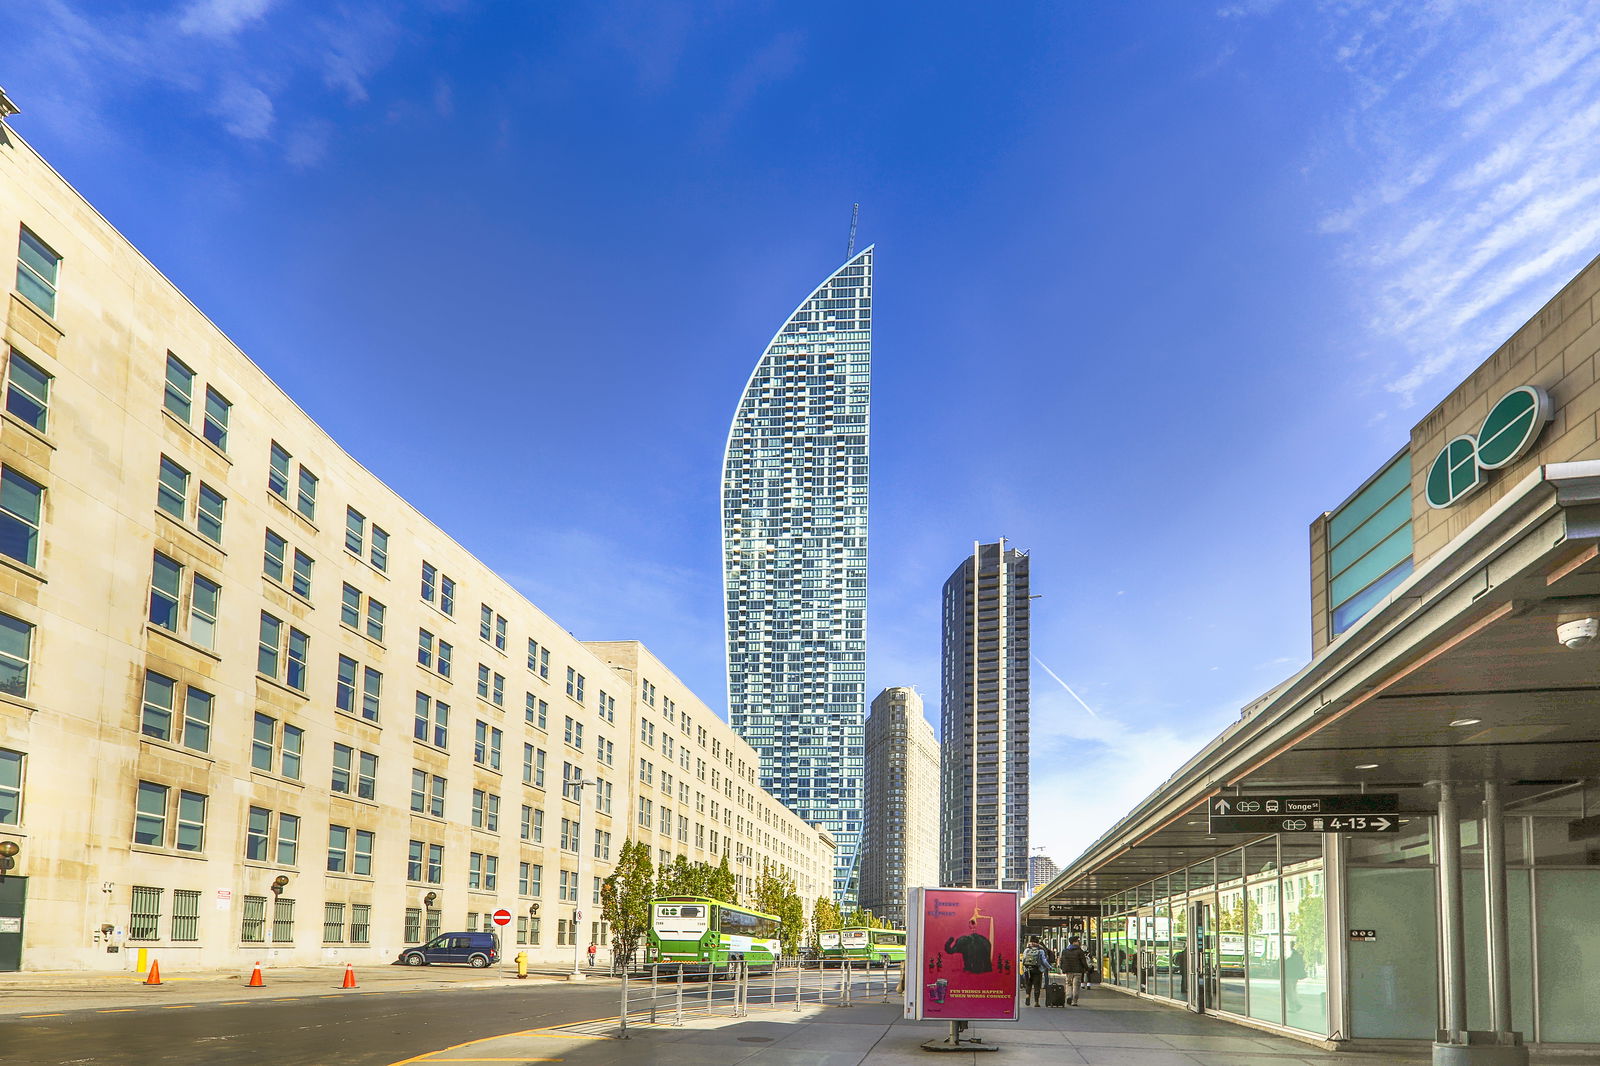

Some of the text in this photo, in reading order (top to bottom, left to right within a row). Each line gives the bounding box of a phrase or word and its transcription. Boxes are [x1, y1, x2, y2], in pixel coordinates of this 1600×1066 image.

[1425, 385, 1540, 510] GO
[1236, 801, 1260, 812] GO
[1287, 803, 1312, 812] Yonge
[1282, 819, 1307, 831] GO
[1330, 817, 1367, 829] 4-13
[661, 907, 678, 916] GO
